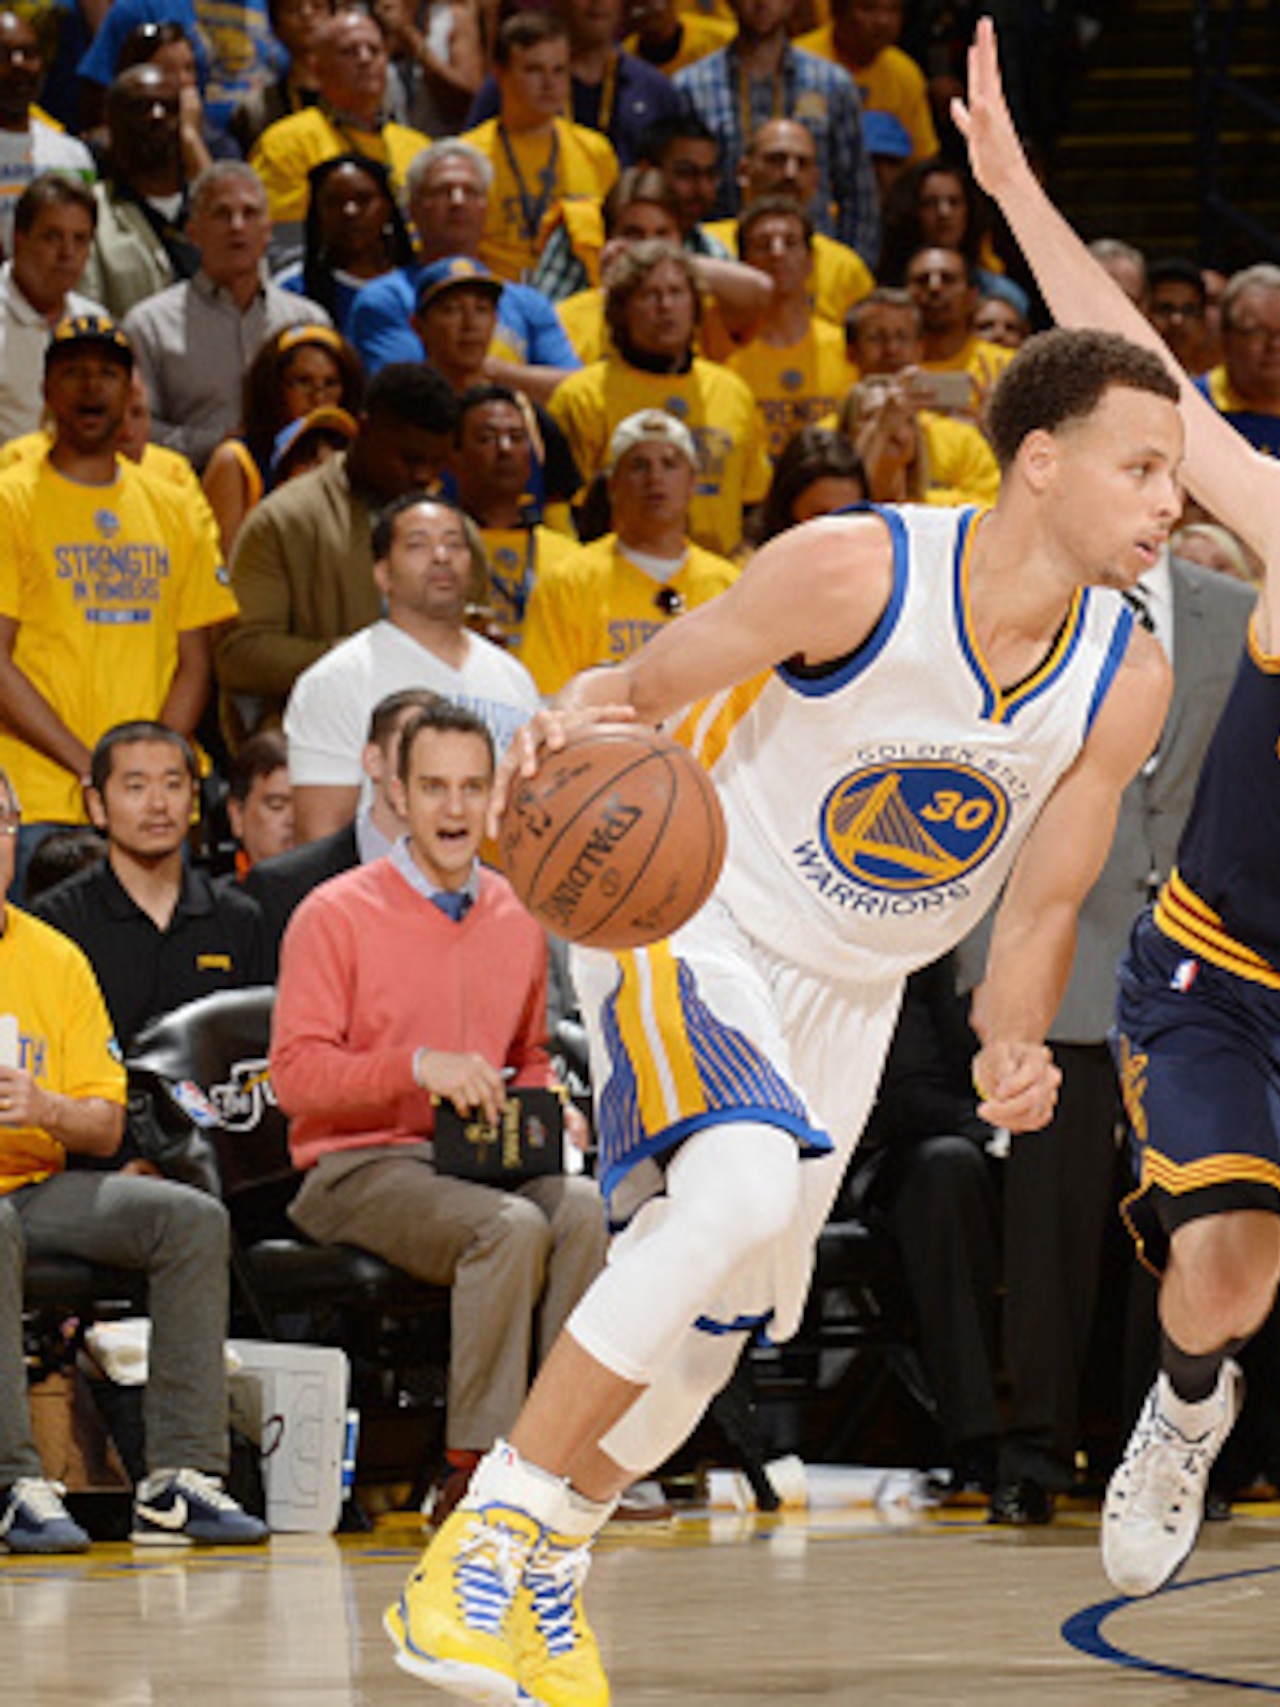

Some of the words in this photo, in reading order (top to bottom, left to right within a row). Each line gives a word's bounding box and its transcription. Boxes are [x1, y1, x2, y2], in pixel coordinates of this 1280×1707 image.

[54, 545, 169, 578] STRENGTH
[856, 745, 974, 762] GOLDEN
[920, 790, 993, 830] 30
[793, 840, 970, 916] WARRIORS
